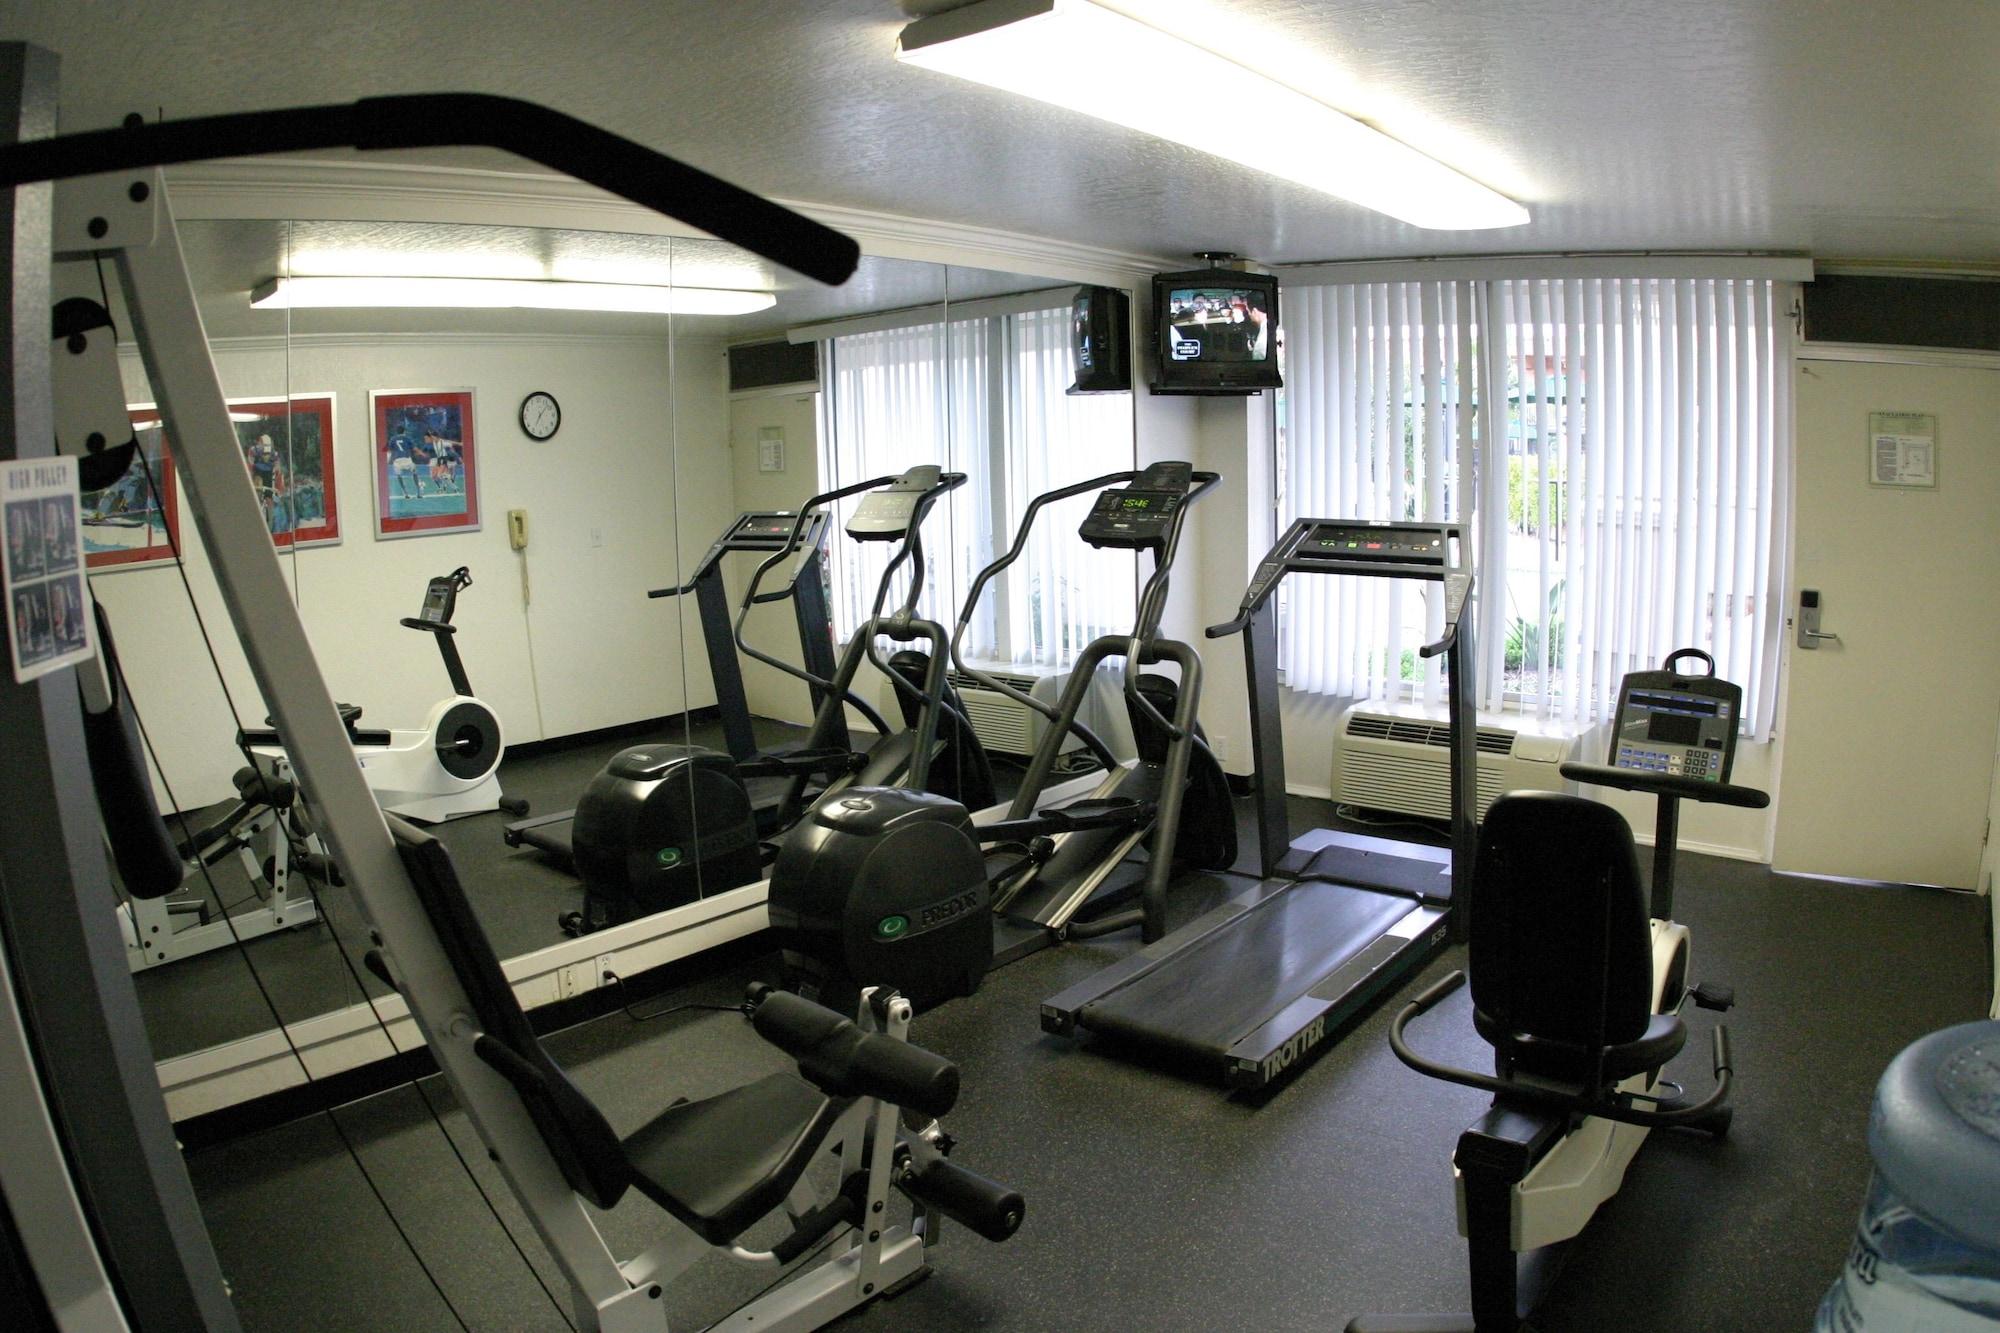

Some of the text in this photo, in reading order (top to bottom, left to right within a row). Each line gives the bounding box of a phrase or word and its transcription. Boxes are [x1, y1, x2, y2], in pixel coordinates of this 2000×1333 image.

[9, 464, 67, 491] HIGH PULLEY
[921, 891, 976, 927] PRECOR
[1263, 1015, 1325, 1083] TROTTER
